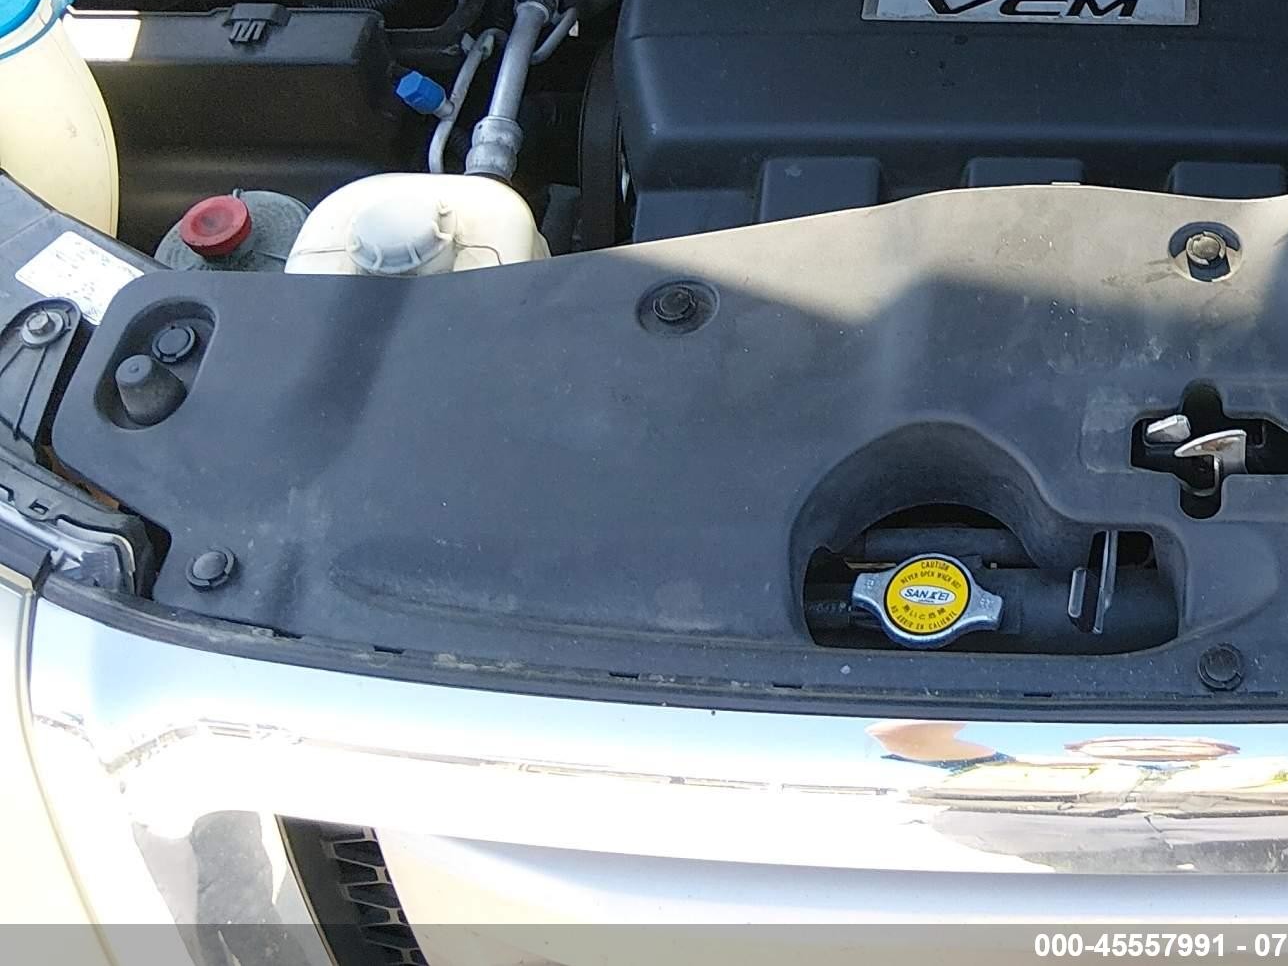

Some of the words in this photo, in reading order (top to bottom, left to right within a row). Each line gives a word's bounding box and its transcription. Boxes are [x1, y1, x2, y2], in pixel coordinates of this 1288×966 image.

[921, 561, 949, 571] CAUTION
[905, 589, 950, 601] SANKEI
[928, 611, 958, 630] CALIENTE
